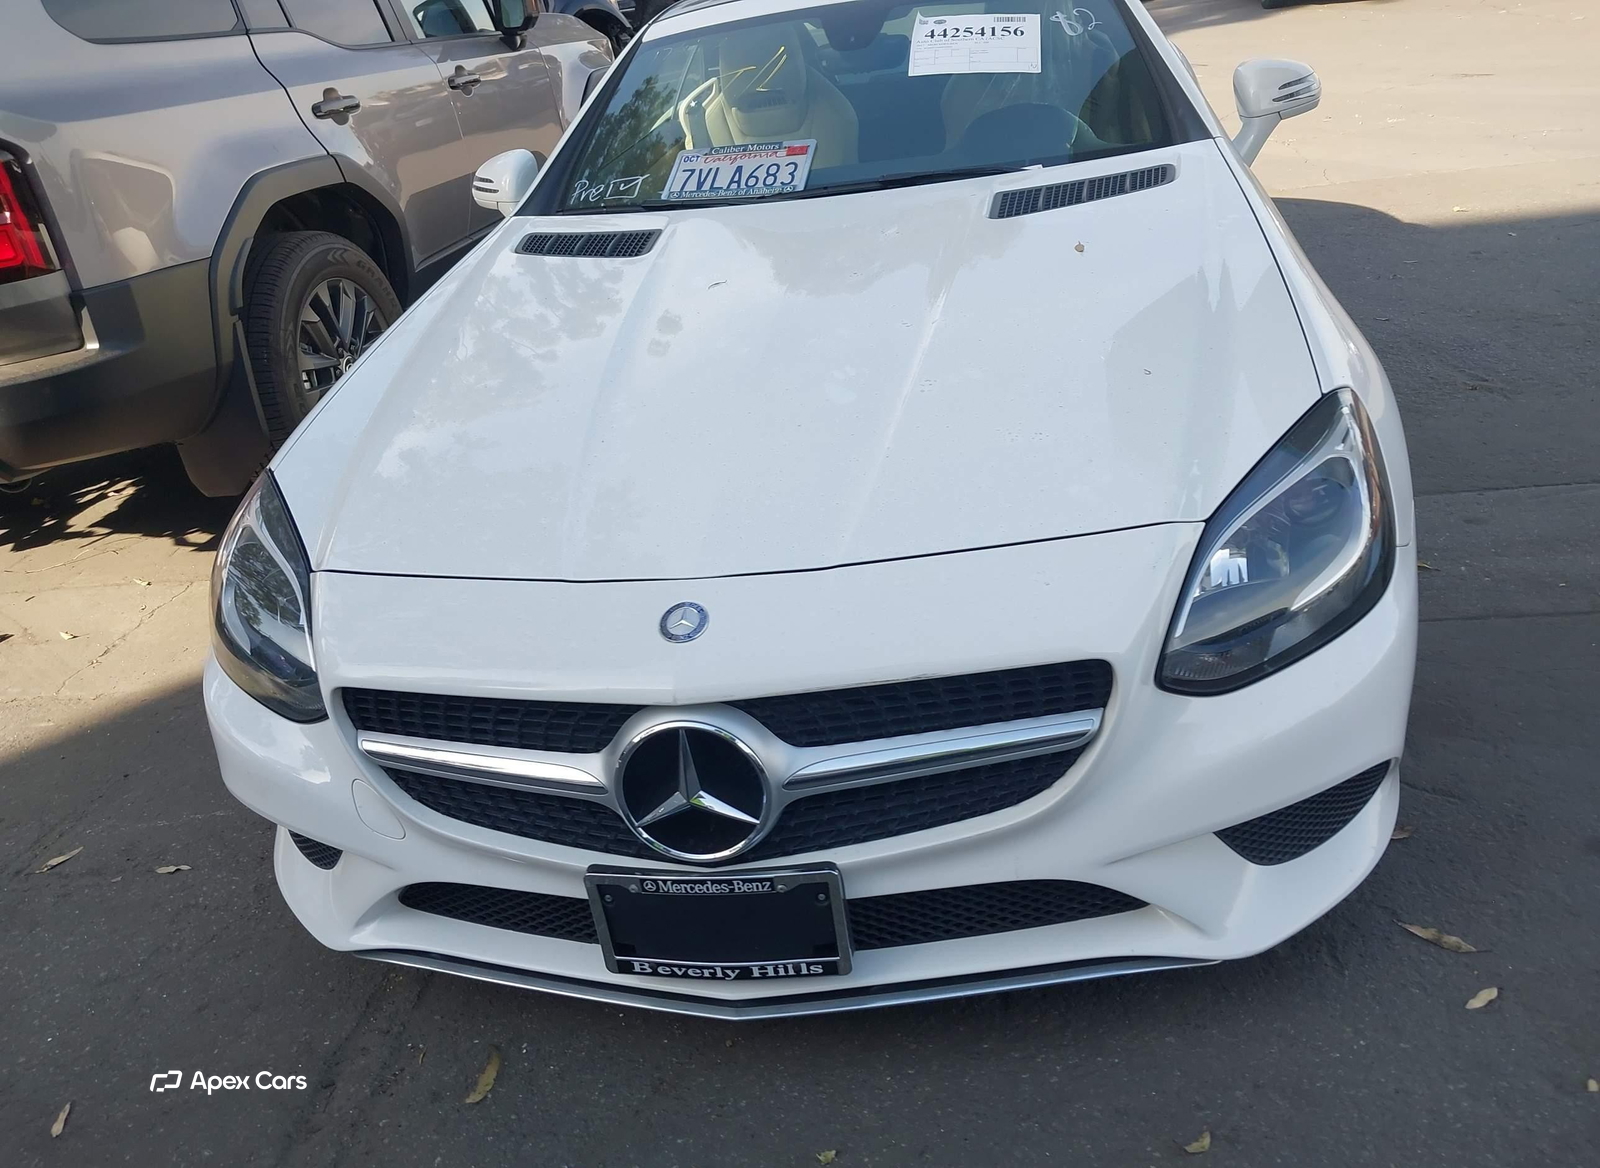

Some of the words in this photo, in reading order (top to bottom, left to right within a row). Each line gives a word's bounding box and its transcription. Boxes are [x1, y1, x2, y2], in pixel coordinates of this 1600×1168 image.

[924, 26, 1025, 39] 44254156
[711, 145, 745, 155] Caliber
[747, 143, 780, 152] Motors
[683, 155, 701, 163] OCT
[703, 151, 781, 165] California
[680, 162, 799, 191] 7VLA683
[681, 189, 737, 198] Mercedes-Benz
[658, 880, 772, 894] Mercedes-Benz
[630, 960, 740, 980] Beverly
[750, 961, 824, 977] Hills
